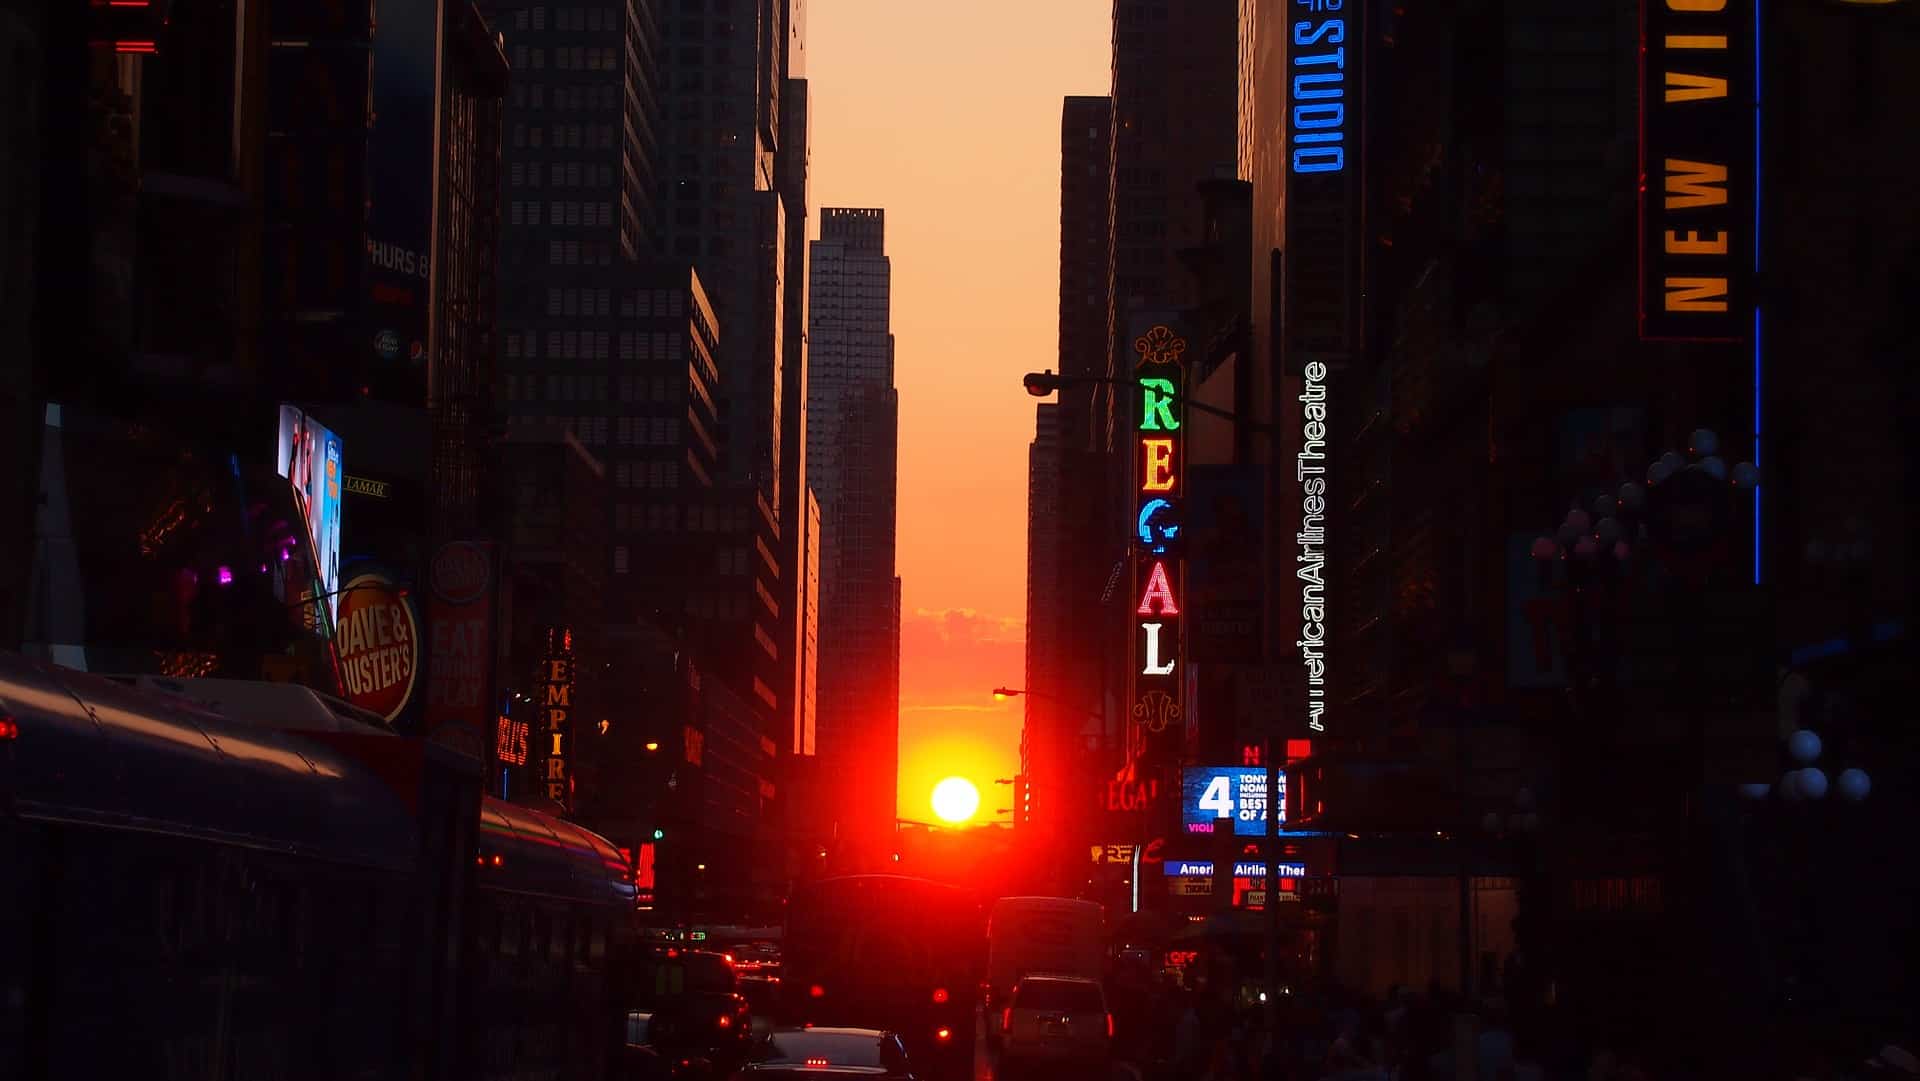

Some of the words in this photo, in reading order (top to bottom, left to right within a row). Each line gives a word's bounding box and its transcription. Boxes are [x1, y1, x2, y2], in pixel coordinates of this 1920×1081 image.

[1294, 19, 1344, 173] STUDIO
[1665, 158, 1727, 312] NEW
[368, 240, 416, 274] HURS
[346, 477, 384, 496] LAMAR
[1137, 377, 1180, 676] REGAL
[337, 604, 391, 658] DAVE
[391, 604, 408, 642] &
[343, 644, 409, 697] USTER'S
[546, 660, 569, 800] EMPIRE
[1100, 779, 1157, 811] EGA
[1199, 776, 1234, 818] 4
[1240, 774, 1267, 783] TONY
[1240, 810, 1257, 820] OF
[1180, 863, 1214, 875] Ameri
[1234, 863, 1266, 875] Airlin
